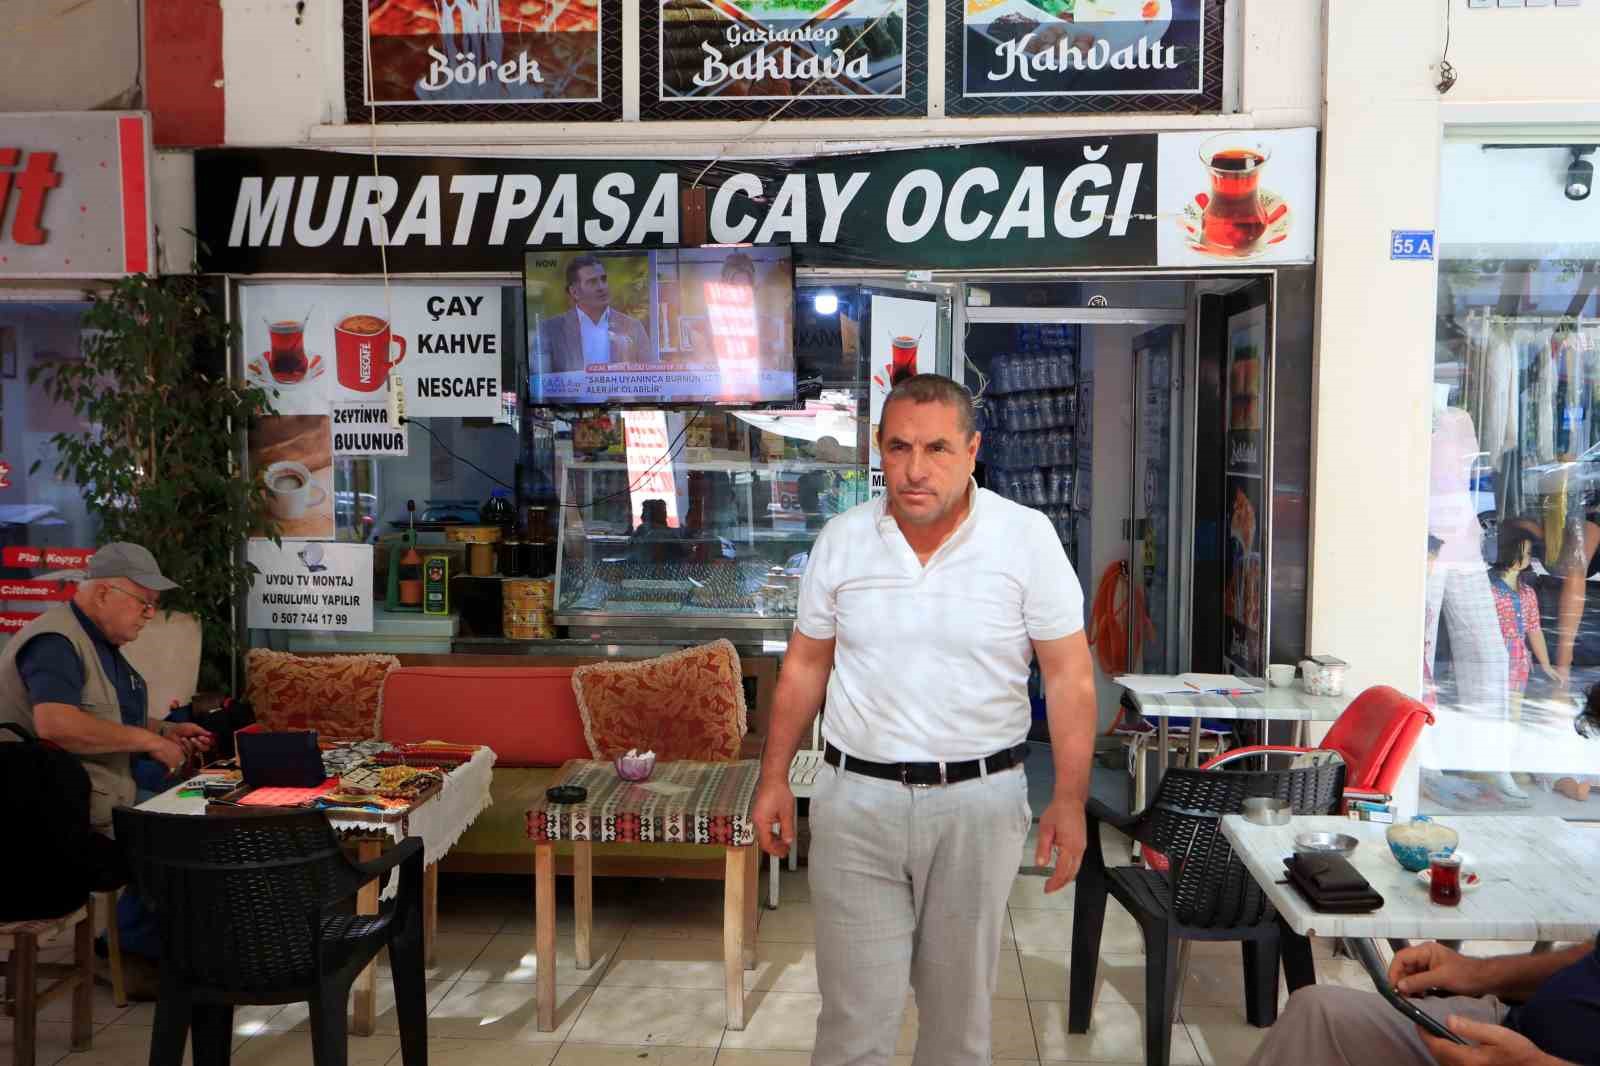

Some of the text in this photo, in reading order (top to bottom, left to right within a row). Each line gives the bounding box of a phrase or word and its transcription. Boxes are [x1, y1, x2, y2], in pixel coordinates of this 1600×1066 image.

[726, 24, 839, 48] Gaziantep
[693, 40, 872, 86] Baklava
[988, 33, 1178, 82] Kahvaltı
[419, 45, 544, 91] Börek
[886, 145, 1143, 242] OCAĞI
[1394, 239, 1432, 254] 55 A
[535, 259, 557, 268] NOW
[427, 295, 485, 322] ÇAY
[417, 334, 497, 354] KAHVE
[417, 377, 497, 397] NESCAFE
[334, 433, 404, 450] BULUNUR
[266, 574, 354, 587] UYDU TV MONTAJ
[262, 593, 361, 607] KURULUMU YAPILIR
[272, 612, 348, 625] 0 507 744 17 99
